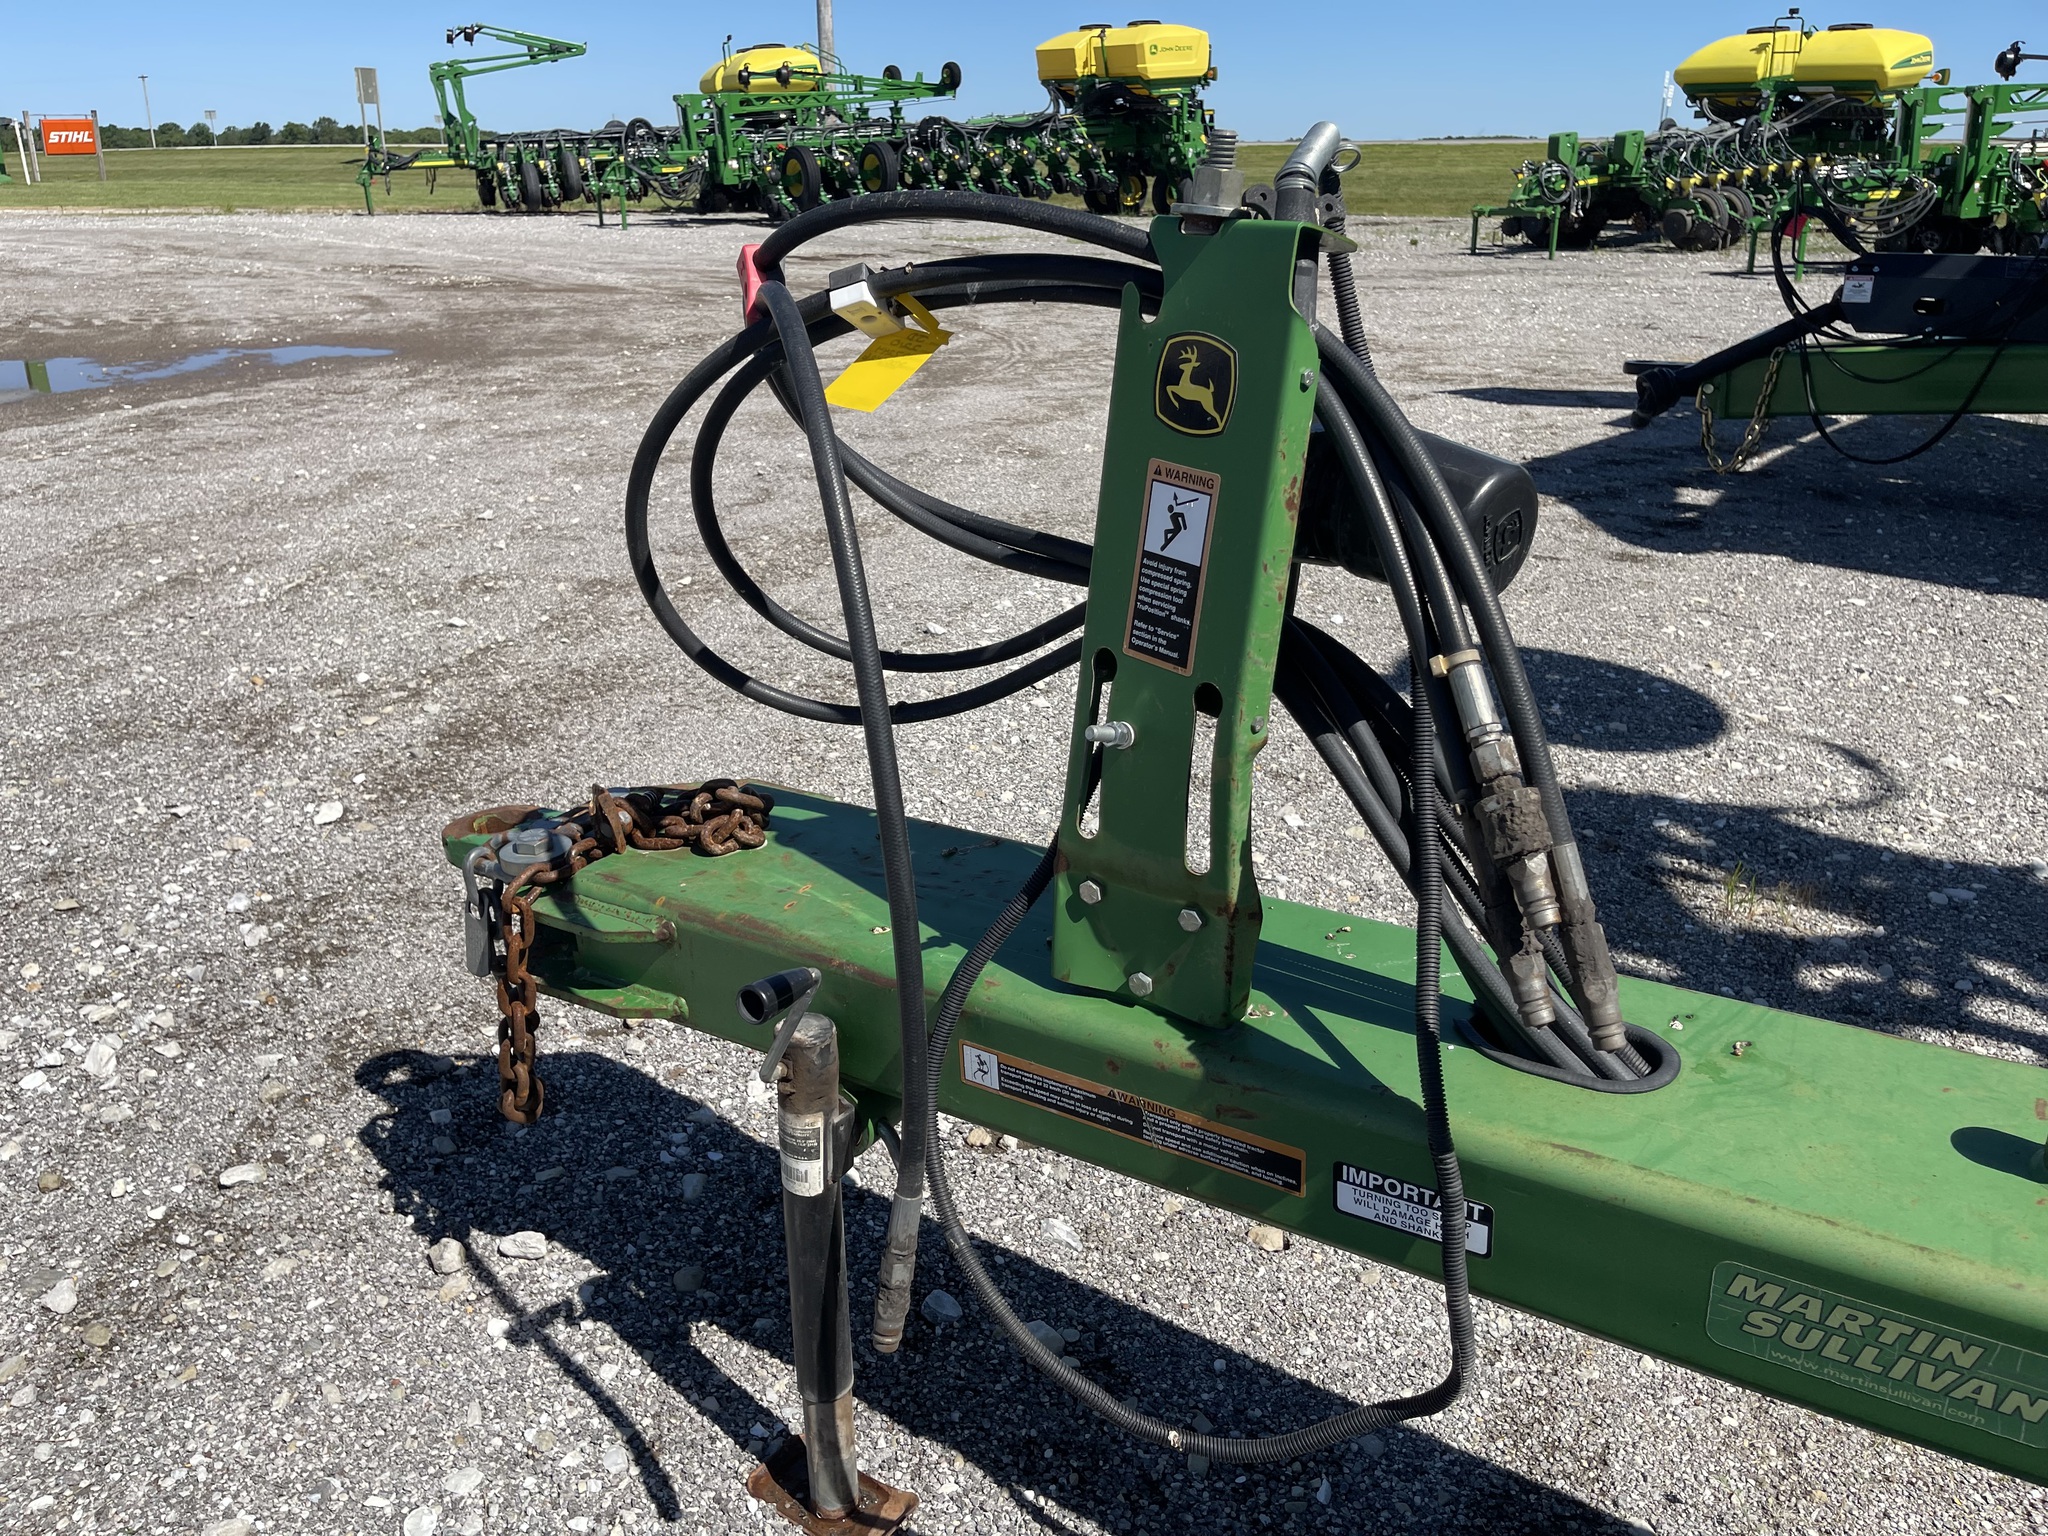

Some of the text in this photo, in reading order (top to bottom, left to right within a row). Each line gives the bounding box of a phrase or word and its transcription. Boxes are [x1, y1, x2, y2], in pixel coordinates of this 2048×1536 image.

[48, 131, 93, 144] STIHL
[1165, 466, 1214, 490] WARNING
[1142, 568, 1173, 582] compressed
[1143, 558, 1187, 576] Avoid injury from
[1139, 586, 1183, 604] compression tool
[1140, 576, 1187, 597] Use special spring
[1138, 595, 1176, 613] when servicing
[1133, 630, 1151, 640] section
[1134, 620, 1148, 629] Refer
[1118, 1092, 1176, 1118] WARNING
[1143, 1129, 1164, 1140] Reuce
[1352, 1187, 1428, 1217] TURNING TOO
[1354, 1197, 1379, 1212] WILL
[1383, 1207, 1431, 1227] DAMAGE
[1374, 1212, 1397, 1226] AND
[1400, 1220, 1443, 1239] SHANK
[1725, 1273, 1987, 1370] MARTIN
[1740, 1310, 2048, 1424] SULLIVAN
[1770, 1349, 1986, 1425] www.martinsullivan.com
